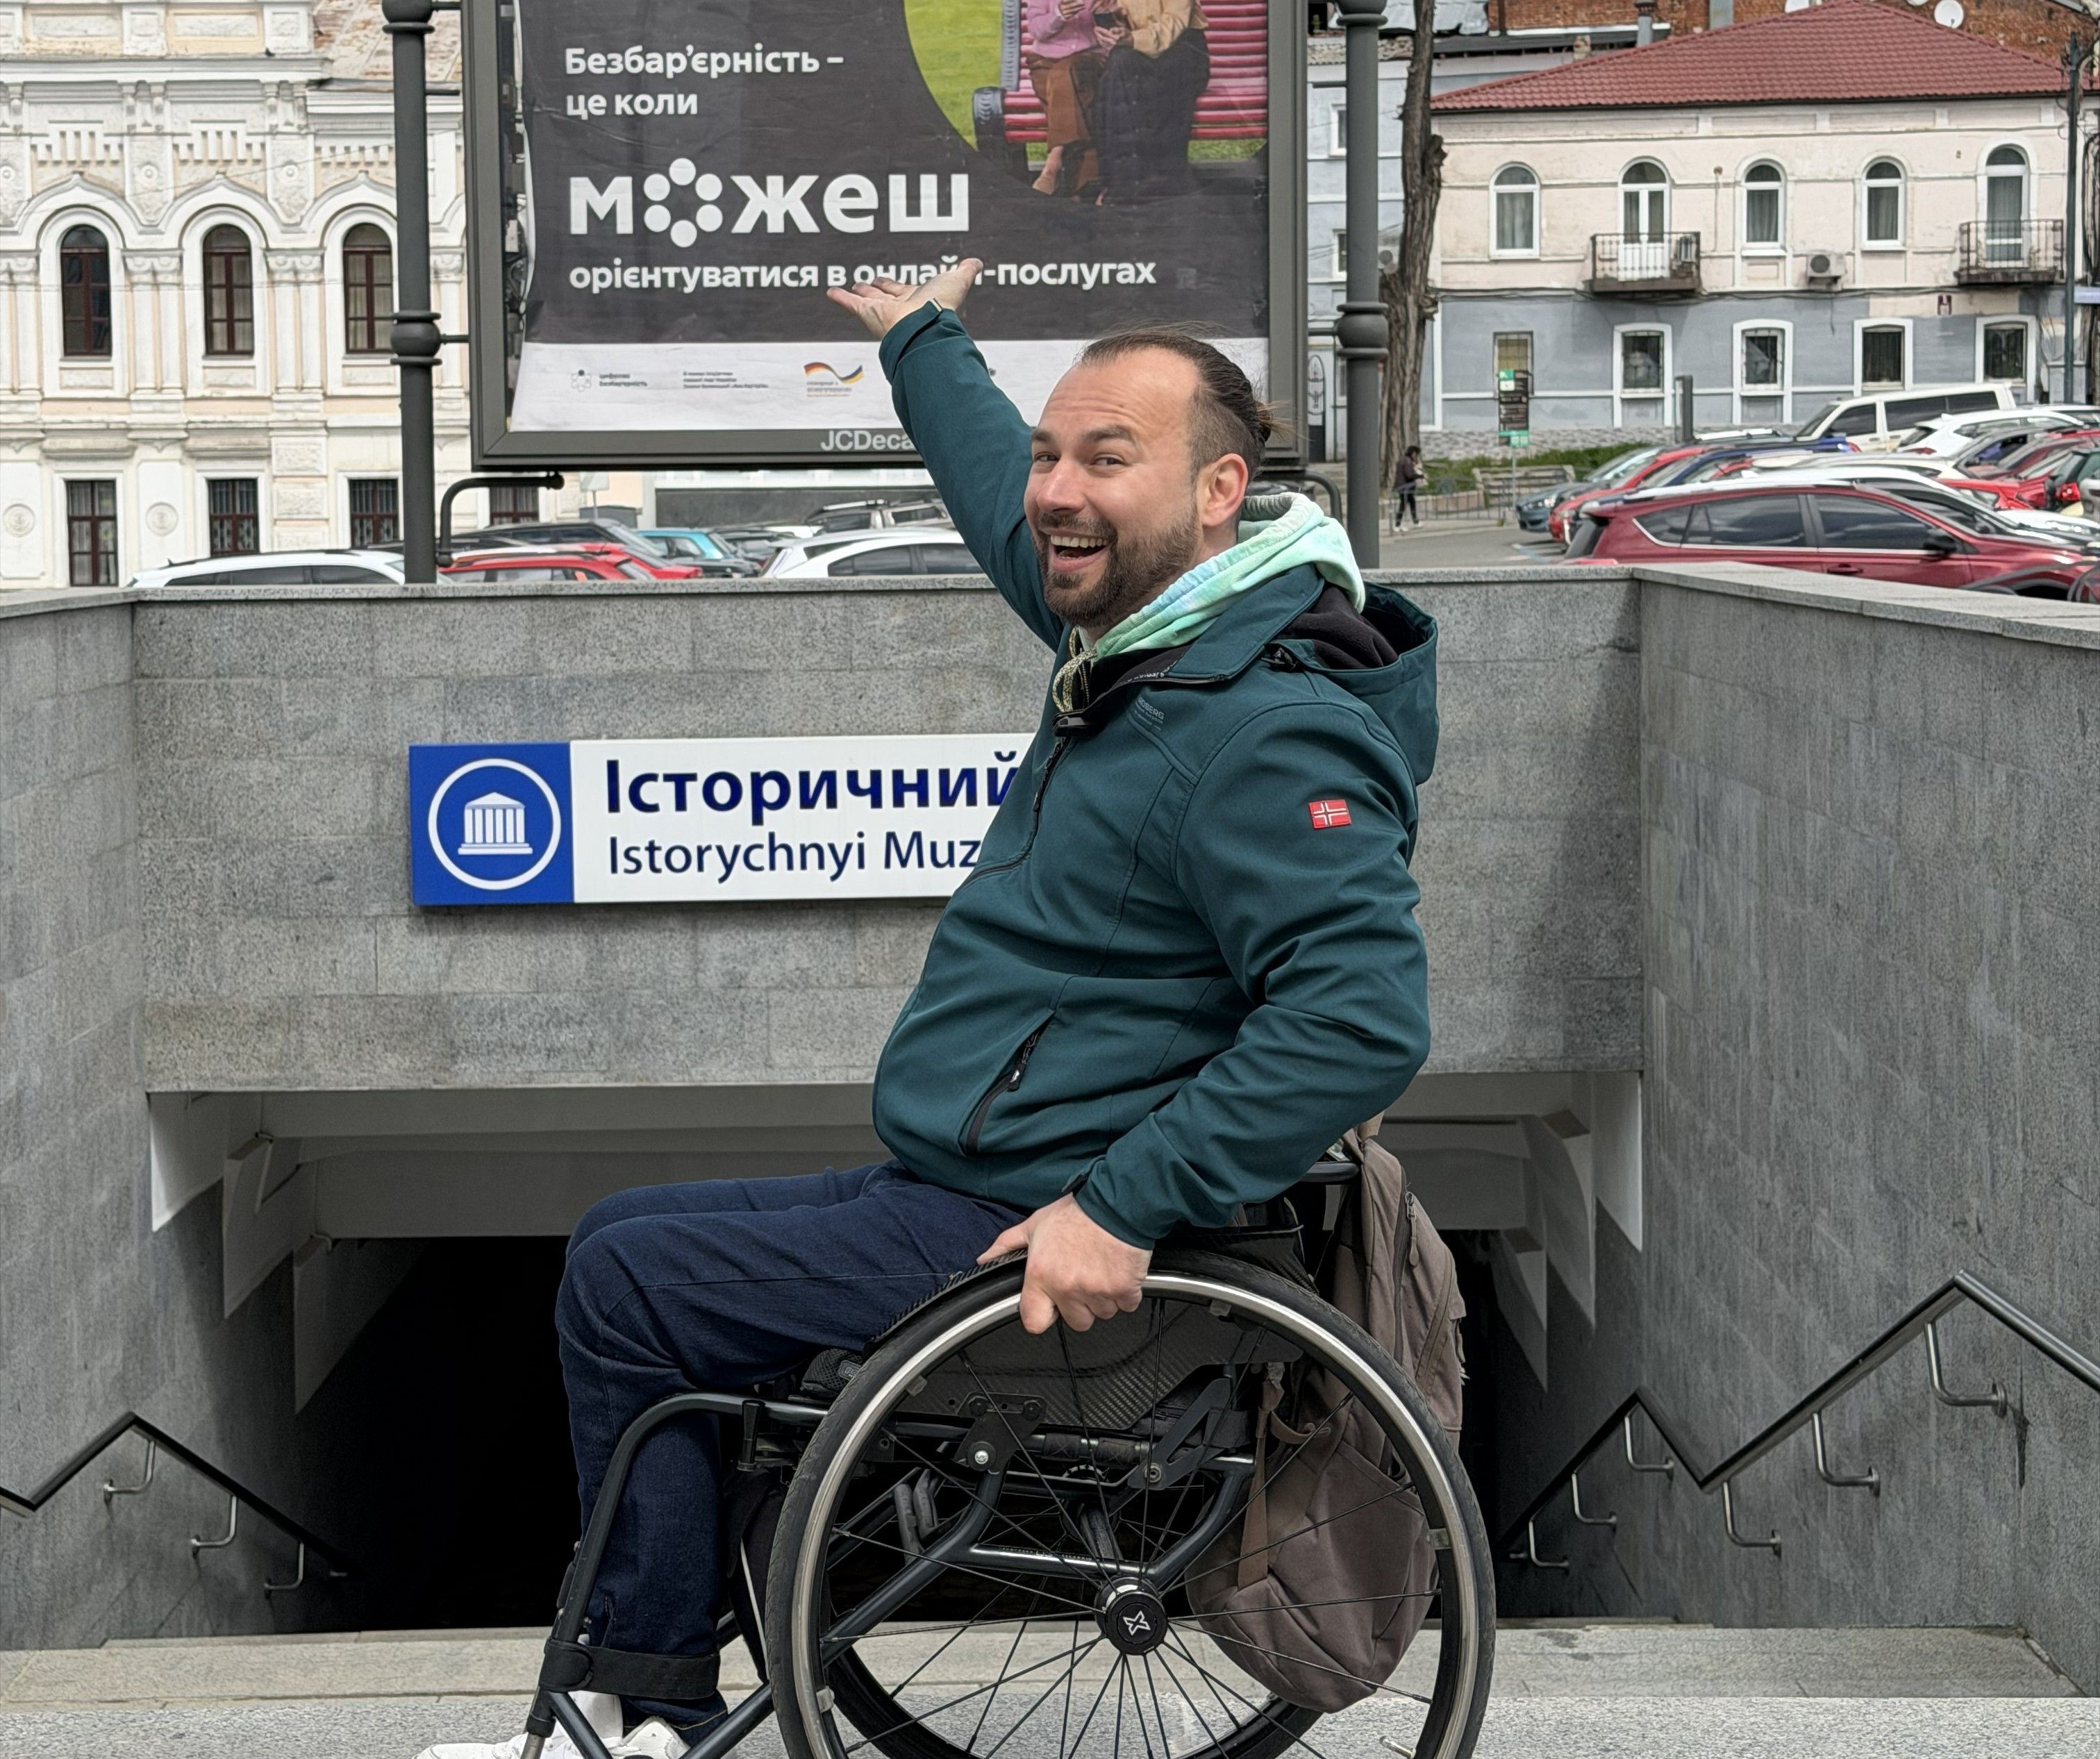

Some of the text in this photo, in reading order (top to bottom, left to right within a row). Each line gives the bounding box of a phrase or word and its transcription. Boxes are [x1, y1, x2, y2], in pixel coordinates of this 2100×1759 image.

[566, 93, 698, 120] це коли
[569, 257, 819, 294] орієнтуватися
[826, 265, 847, 287] в
[820, 430, 917, 451] JCDeca
[606, 750, 1020, 826] Історичний
[610, 831, 981, 884] Istorychnyi Muz
